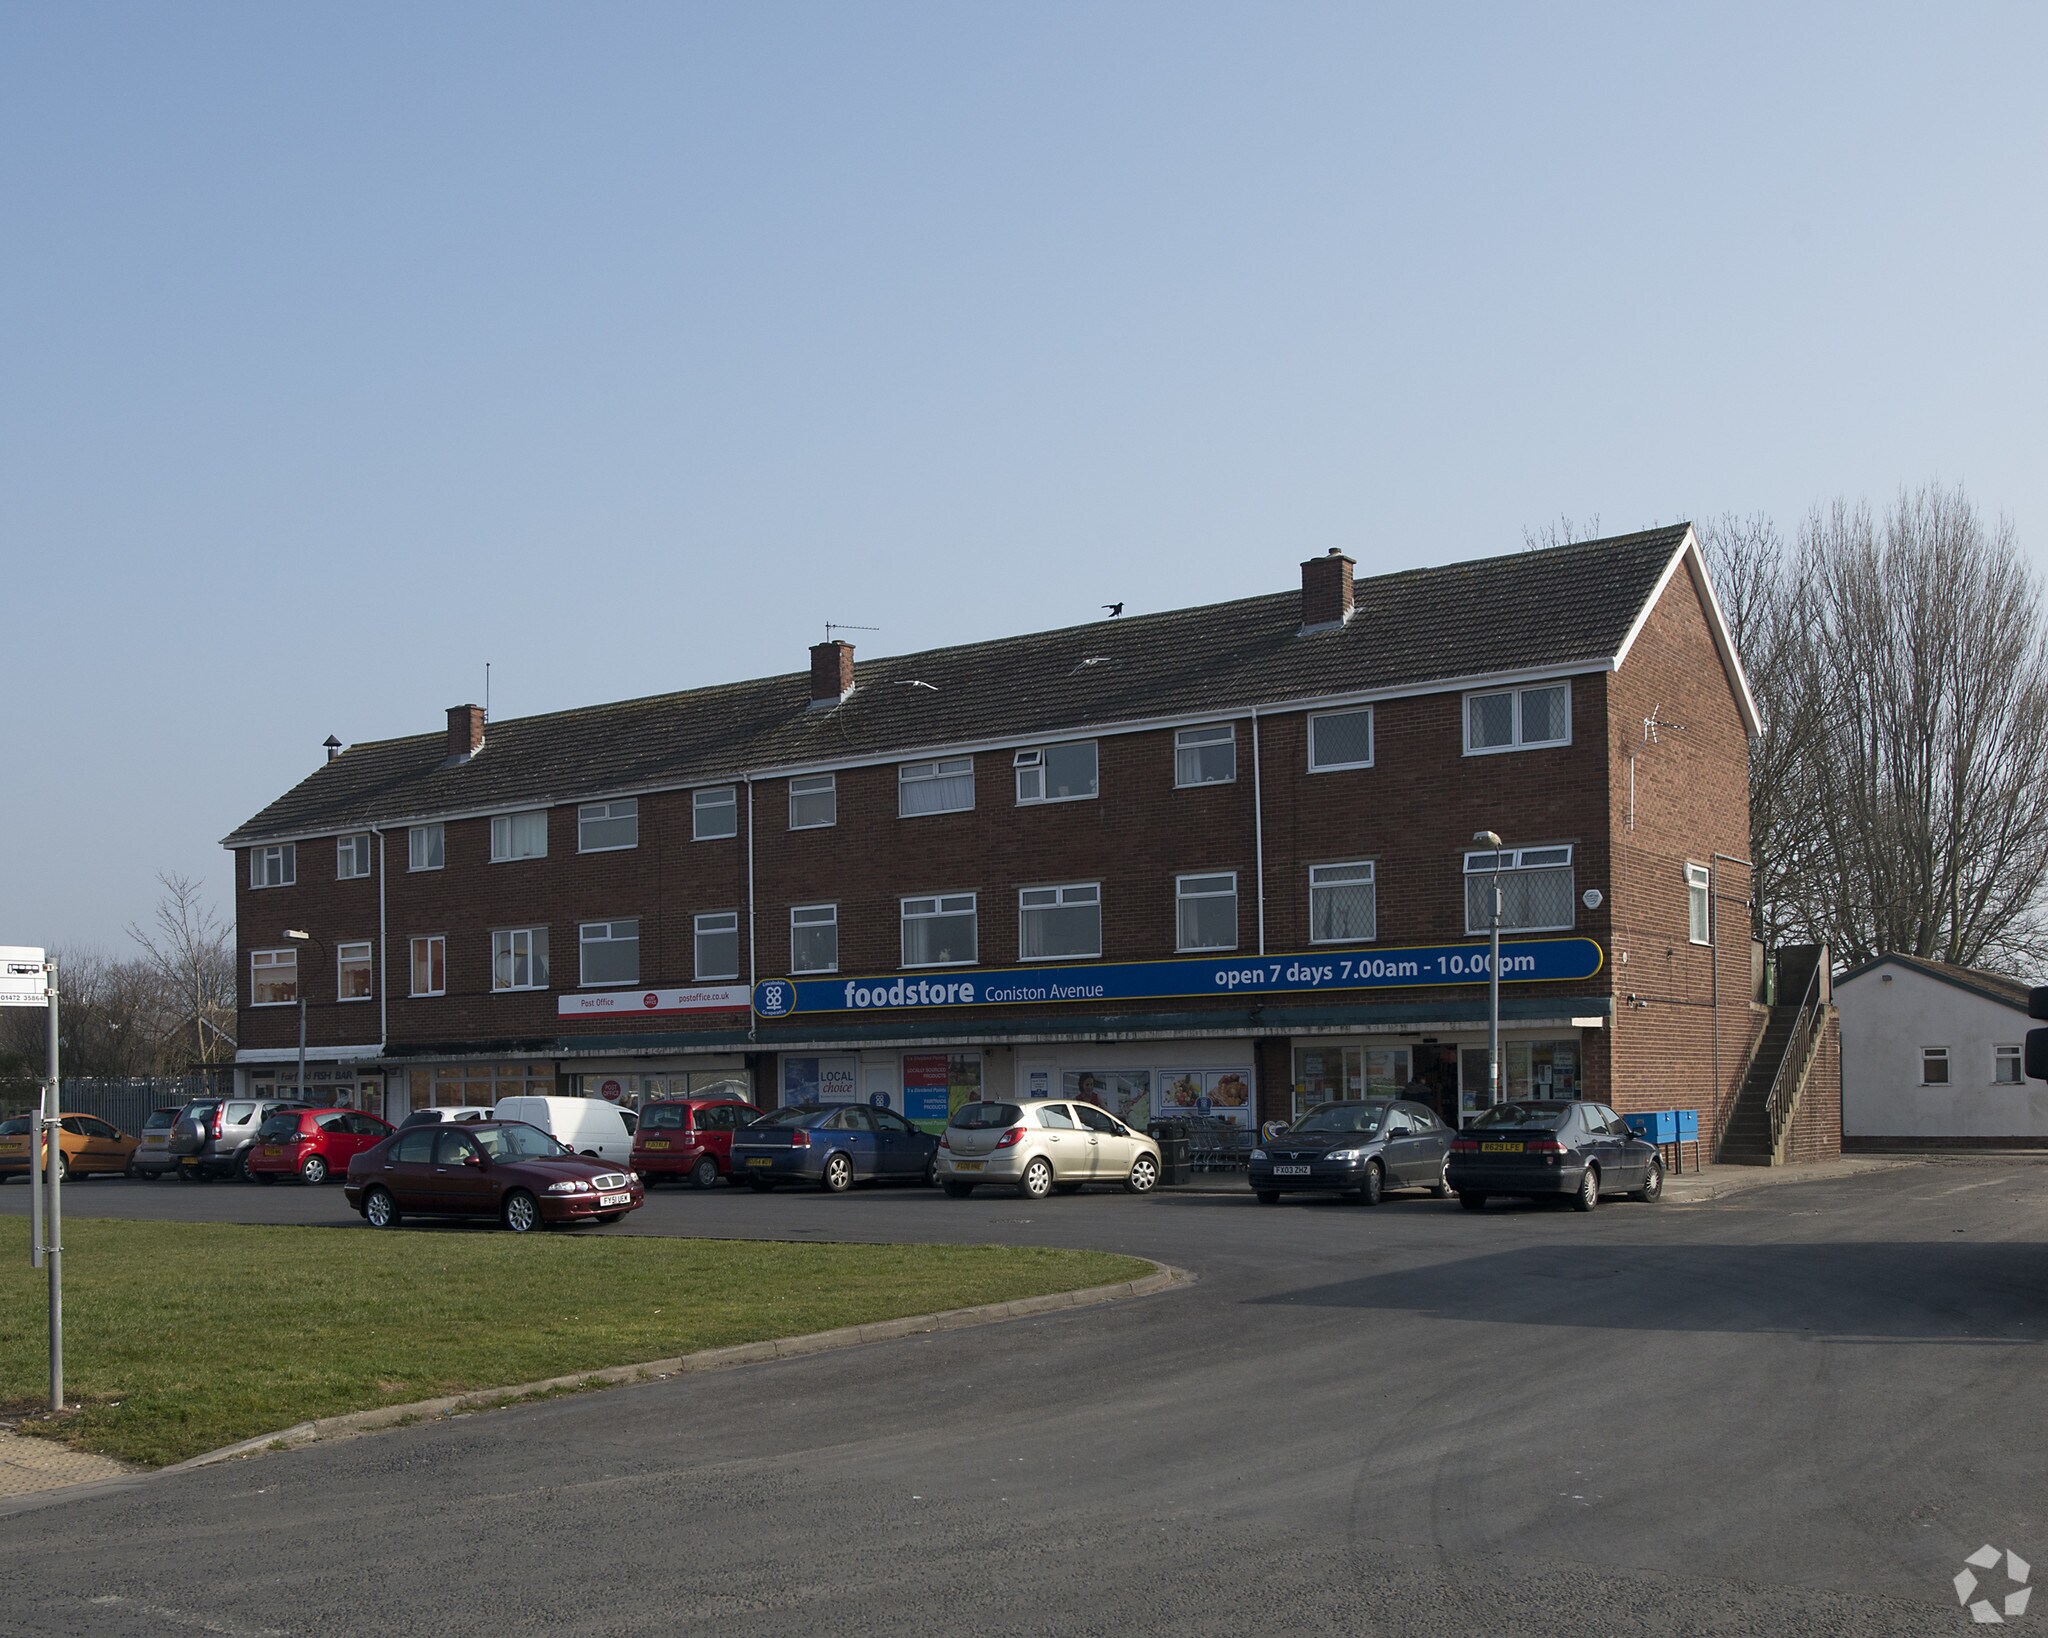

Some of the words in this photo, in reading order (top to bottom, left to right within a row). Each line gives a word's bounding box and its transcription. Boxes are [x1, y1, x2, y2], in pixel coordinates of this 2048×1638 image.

[1214, 968, 1264, 989] open
[1269, 964, 1281, 983] 7
[1286, 962, 1333, 986] days
[1340, 959, 1418, 979] 7.00am
[678, 992, 730, 1004] postoffice.co.uk
[844, 978, 975, 1008] foodstore
[985, 985, 1046, 1002] Coniston
[1049, 983, 1104, 999] Avenue
[581, 999, 594, 1007] Post
[596, 998, 614, 1006] Office
[281, 1071, 312, 1081] Fairfld
[313, 1071, 332, 1080] FISH
[335, 1070, 353, 1079] BAR
[821, 1071, 854, 1082] LOCAL
[823, 1081, 853, 1093] choice
[1484, 1143, 1504, 1151] R629
[1505, 1143, 1520, 1151] LFE
[1276, 1166, 1293, 1174] FX03
[604, 1196, 617, 1204] FY51
